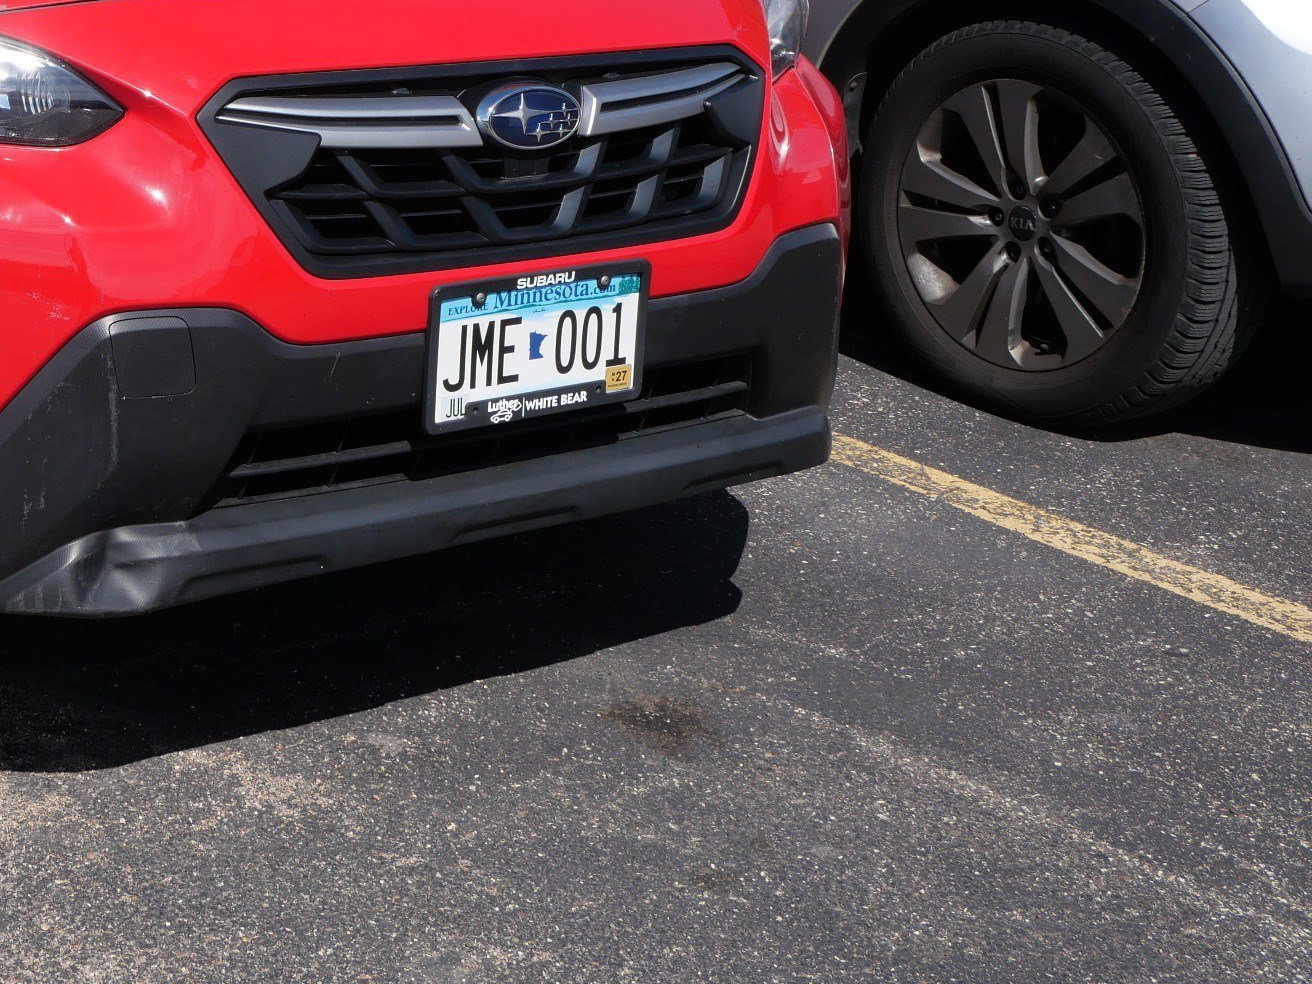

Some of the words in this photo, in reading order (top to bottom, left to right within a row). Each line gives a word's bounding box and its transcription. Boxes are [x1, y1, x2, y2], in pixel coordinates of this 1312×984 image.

[517, 271, 576, 289] SUBARU
[442, 317, 523, 392] JME
[555, 302, 626, 374] 001
[616, 370, 627, 382] 27
[446, 397, 466, 418] JUL
[488, 397, 519, 413] Luther
[526, 395, 559, 411] WHITE
[560, 391, 588, 405] BEAR
